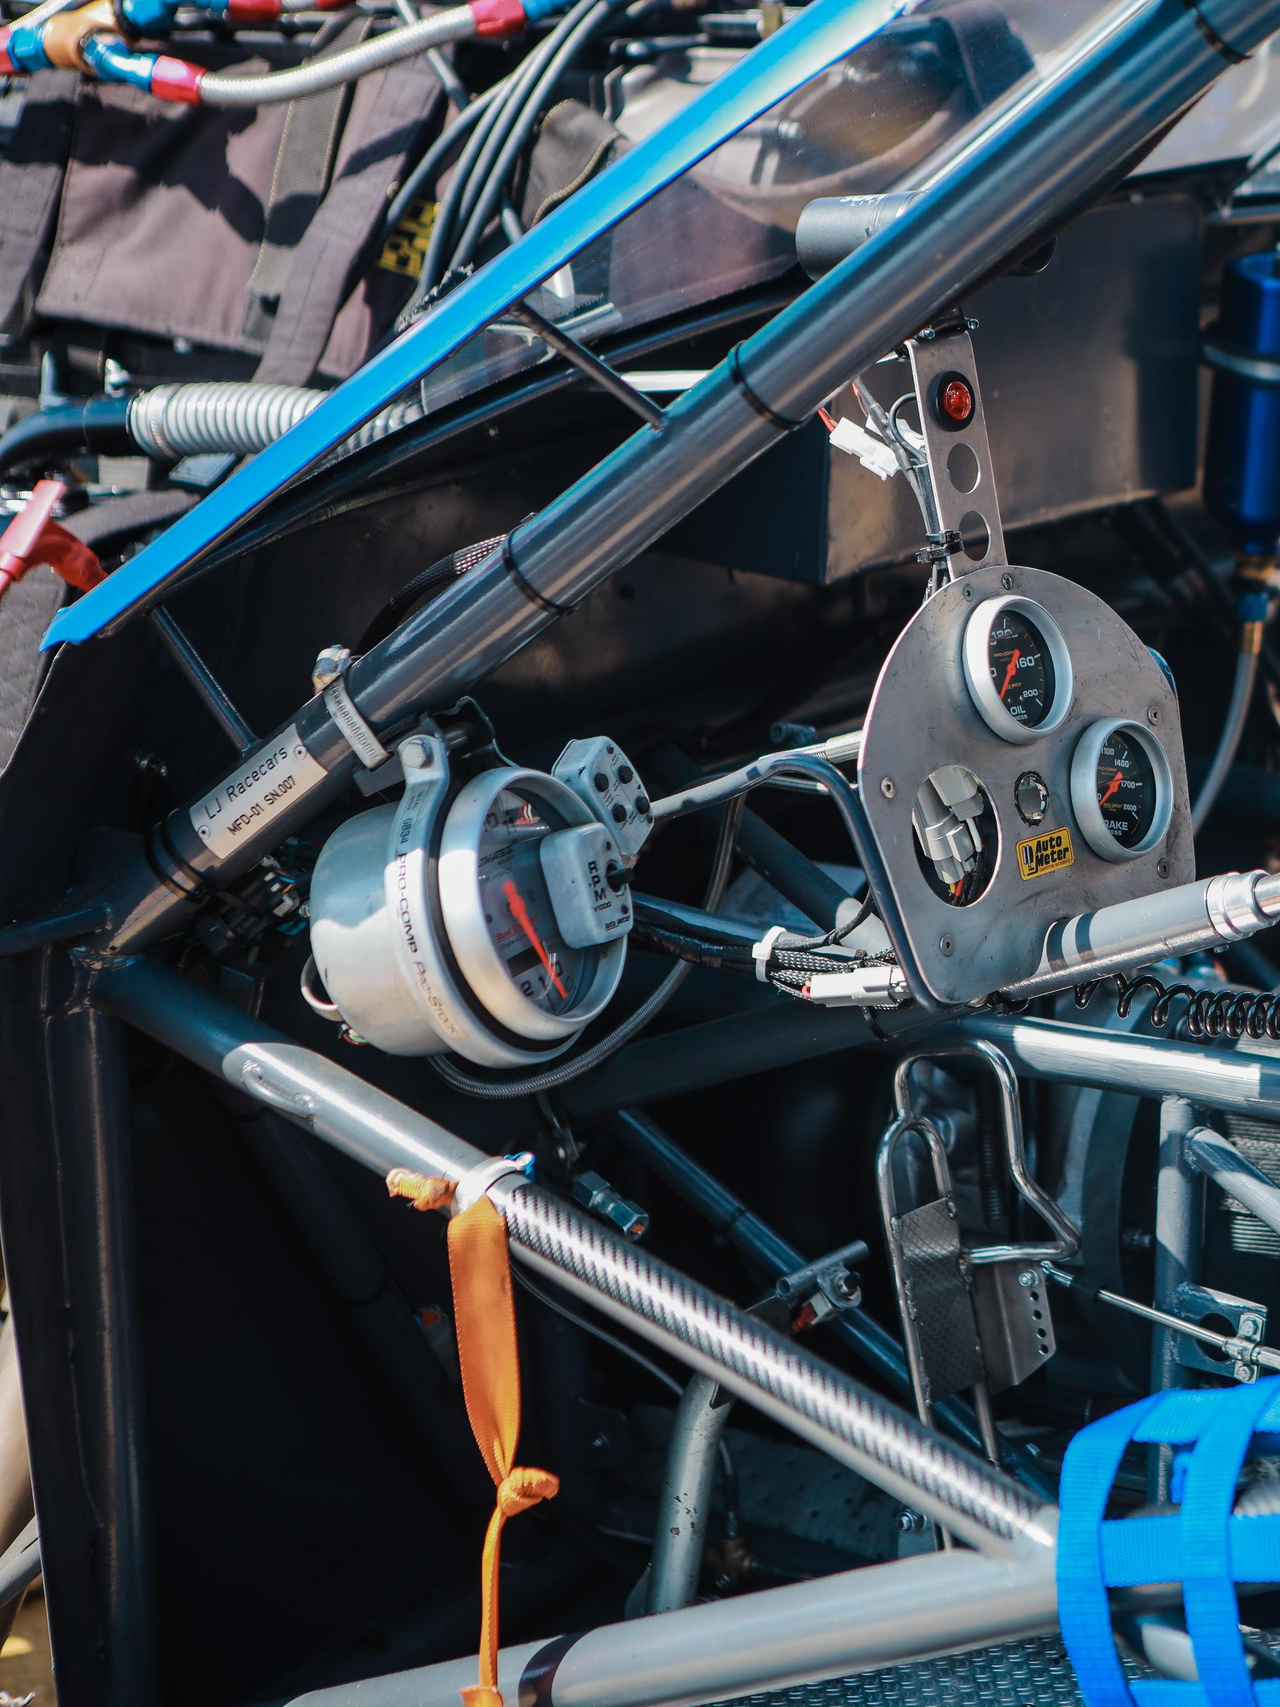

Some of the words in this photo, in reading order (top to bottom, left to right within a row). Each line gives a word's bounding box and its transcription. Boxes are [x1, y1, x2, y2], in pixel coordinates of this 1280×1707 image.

[1015, 656, 1035, 669] 160
[1022, 688, 1038, 698] 200
[1010, 705, 1026, 716] OIL
[1114, 759, 1130, 768] 1400
[204, 797, 222, 820] LJ
[225, 747, 288, 802] Racecars
[1120, 780, 1136, 789] 1700
[1123, 803, 1137, 812] 2000
[226, 802, 265, 836] MFD-01
[1104, 820, 1128, 831] RAKE
[400, 817, 412, 844] 6834
[1036, 835, 1062, 854] Auto
[1033, 846, 1069, 872] Meter
[398, 853, 419, 954] PRO-COMP
